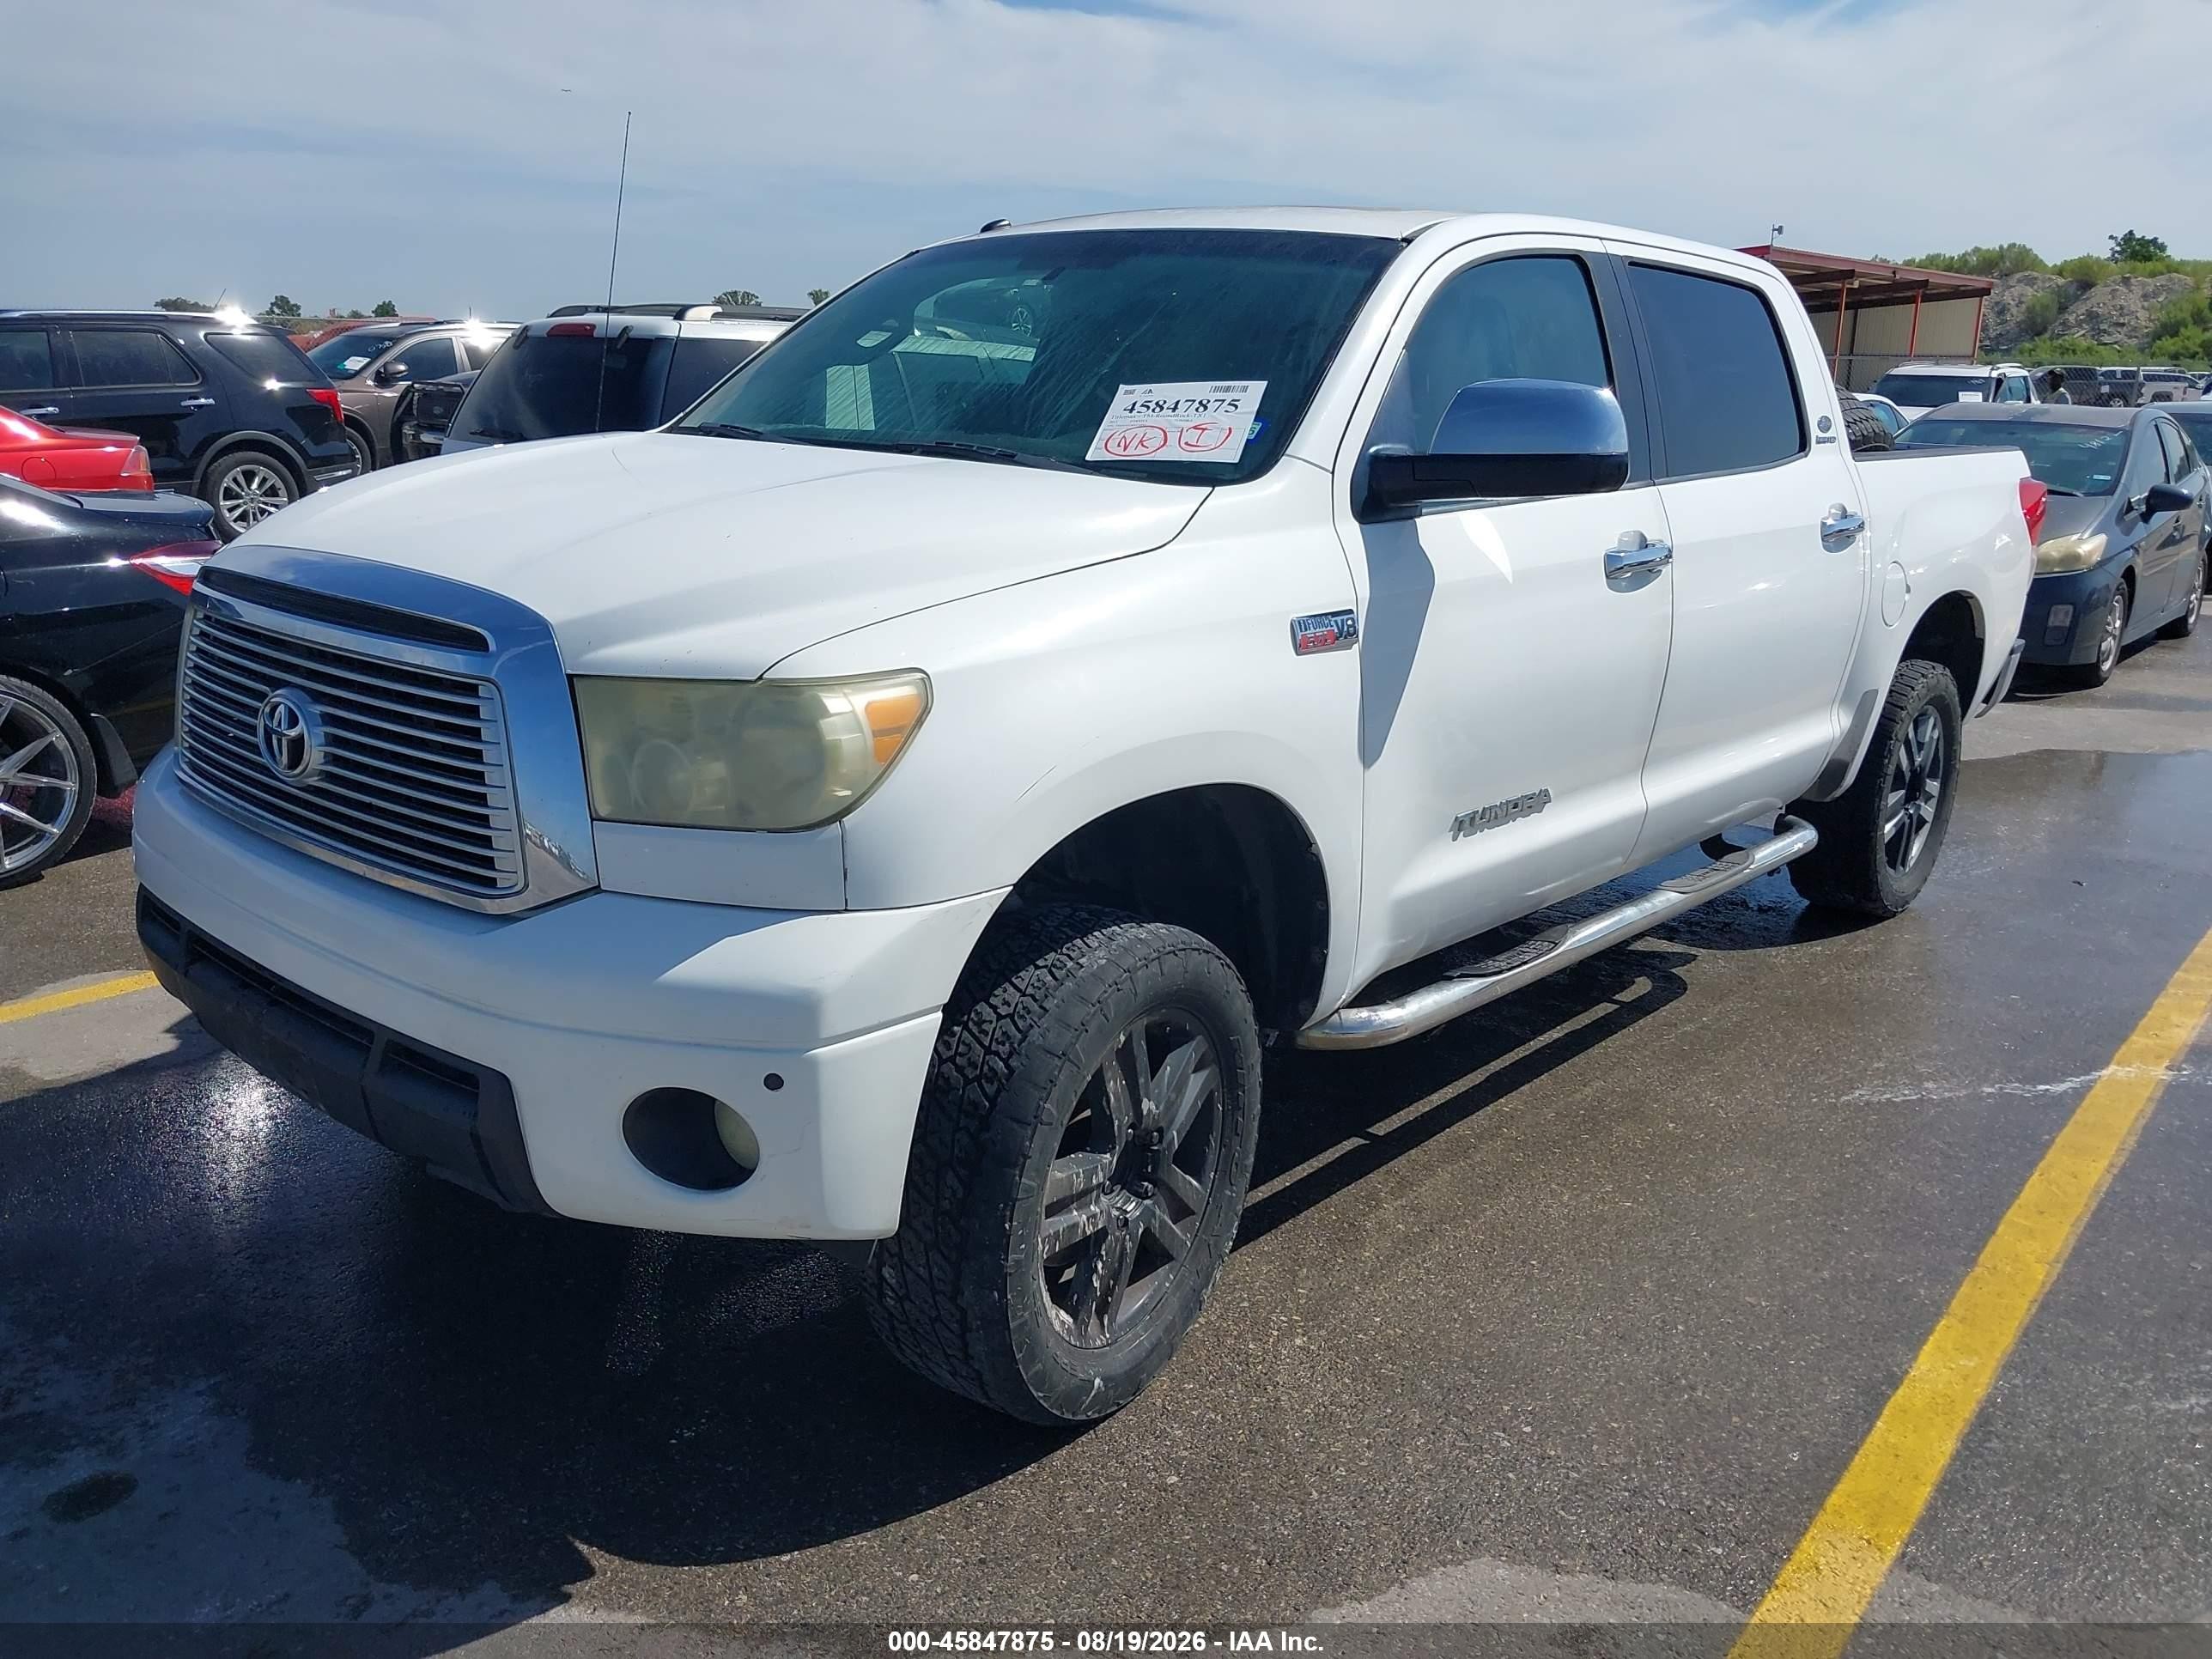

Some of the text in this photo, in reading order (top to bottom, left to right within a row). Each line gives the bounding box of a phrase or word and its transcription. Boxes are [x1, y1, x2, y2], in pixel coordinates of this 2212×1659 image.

[1122, 398, 1242, 414] 45847875
[1117, 431, 1157, 453] NK
[1334, 616, 1357, 639] V8
[1448, 787, 1552, 842] TUNDRA
